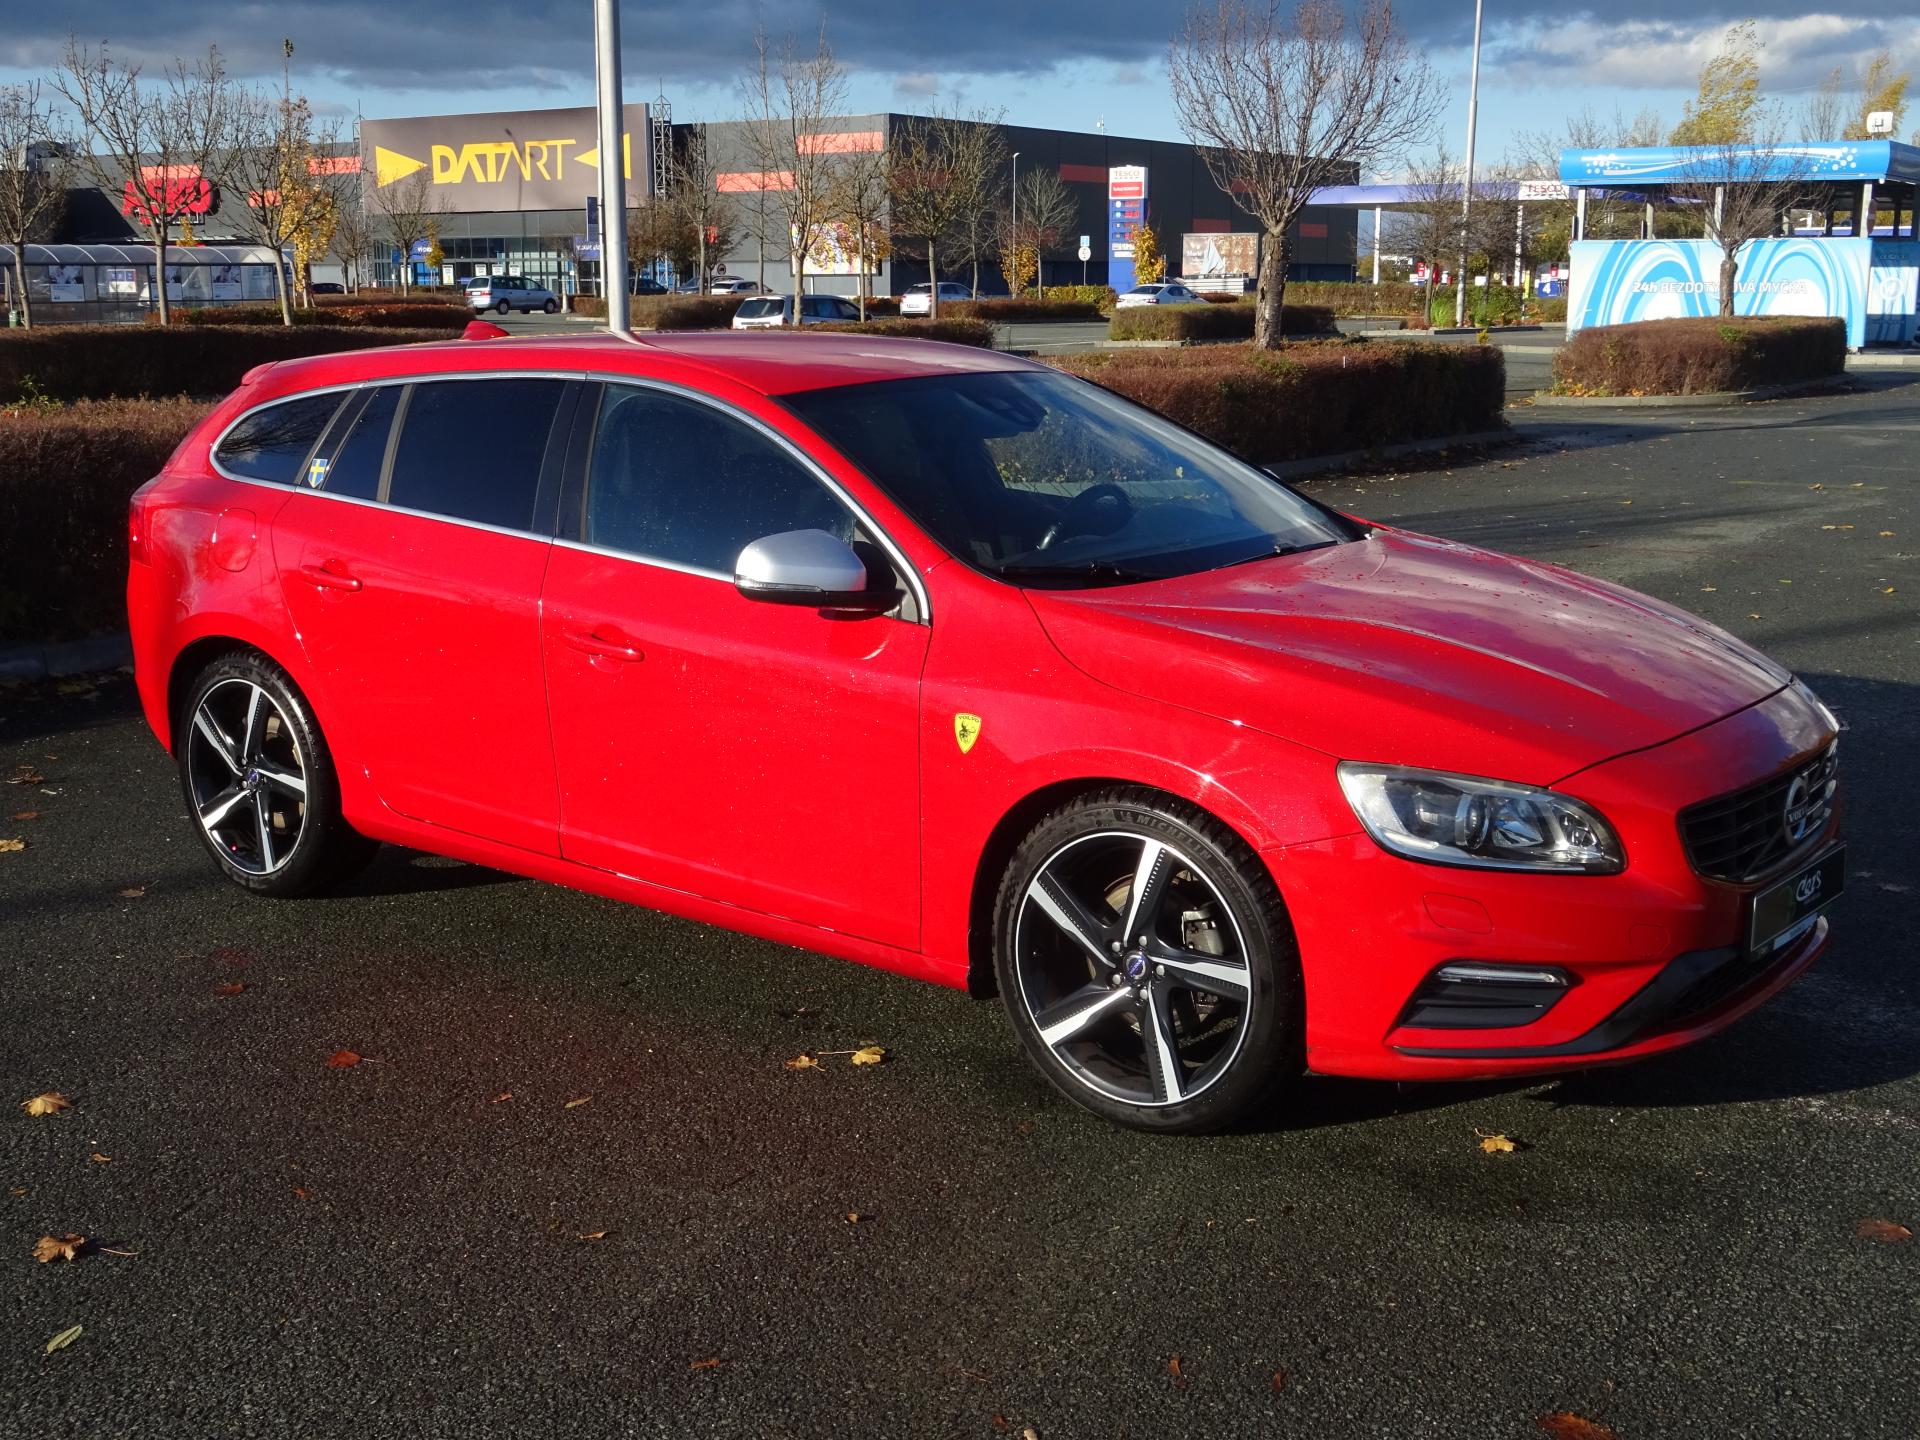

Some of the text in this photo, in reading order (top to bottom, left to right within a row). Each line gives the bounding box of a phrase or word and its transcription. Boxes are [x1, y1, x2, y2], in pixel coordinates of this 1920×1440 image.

[432, 139, 576, 184] DATART
[1528, 184, 1562, 193] TESCO
[1542, 282, 1551, 294] 4
[1632, 281, 1657, 293] 24h
[1660, 280, 1755, 294] BEZDOTYOVÁ
[1137, 814, 1212, 860] MICHELIN
